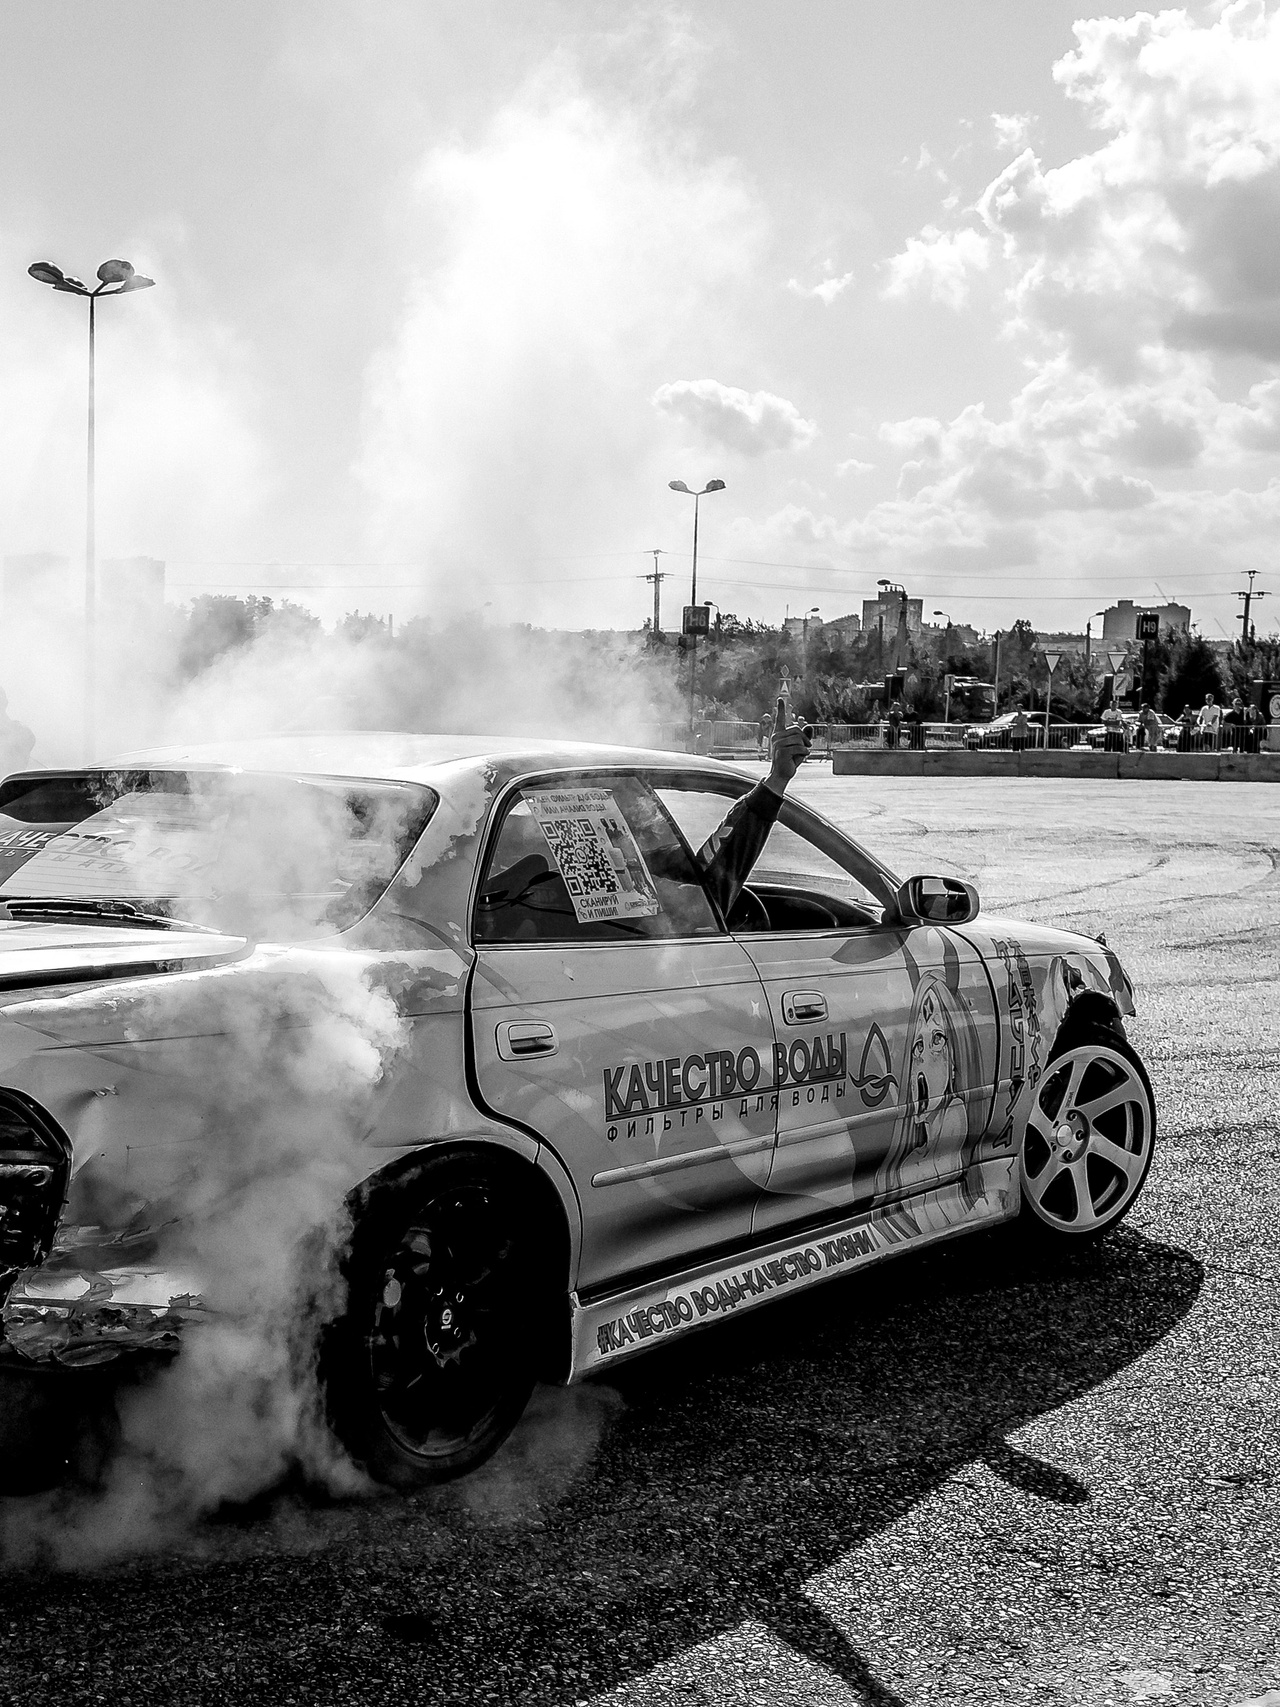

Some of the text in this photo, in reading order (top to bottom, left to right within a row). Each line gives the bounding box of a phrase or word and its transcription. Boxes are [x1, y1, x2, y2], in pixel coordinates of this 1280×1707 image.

[1142, 620, 1158, 634] H9
[580, 894, 619, 908] СКАНИРУЙ
[602, 1032, 847, 1117] КАЧЕСТВО ВОДЫ
[606, 1082, 847, 1142] ФИЛЬТРЫ ДЛЯ ВОДЫ
[596, 1295, 694, 1356] #КАЧЕСТВО
[816, 1229, 876, 1268] ЖИЗНИ
